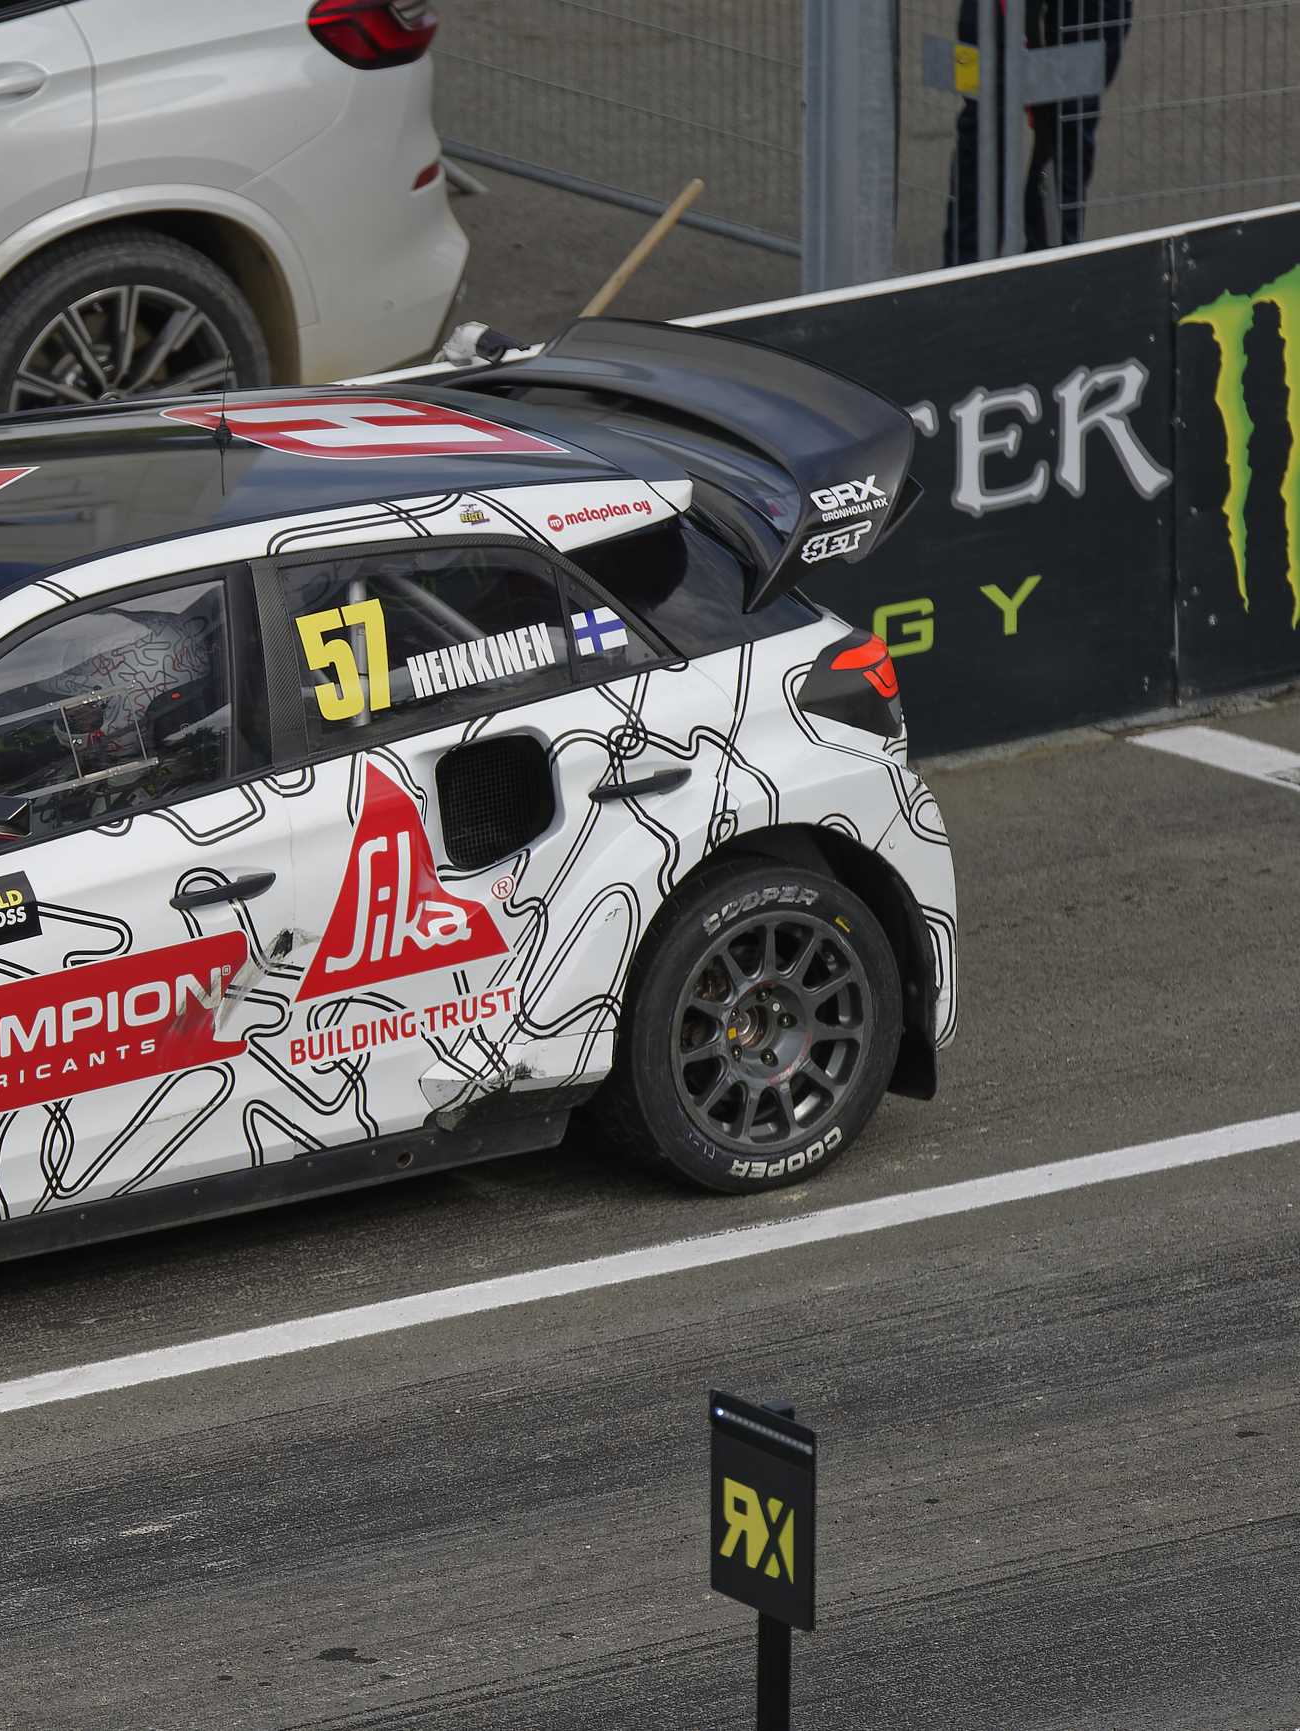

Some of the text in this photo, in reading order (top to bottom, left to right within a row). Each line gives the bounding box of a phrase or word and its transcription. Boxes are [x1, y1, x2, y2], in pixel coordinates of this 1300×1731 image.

[905, 357, 1172, 517] ER
[564, 503, 630, 526] metaplan
[633, 500, 652, 515] oy
[810, 475, 886, 511] GRX
[873, 497, 888, 509] RX
[294, 598, 392, 721] 57
[406, 622, 556, 699] HEIKKINEN
[324, 831, 472, 973] Sika
[290, 986, 516, 1066] BUILDING TRUST
[728, 1126, 843, 1178] COOPER
